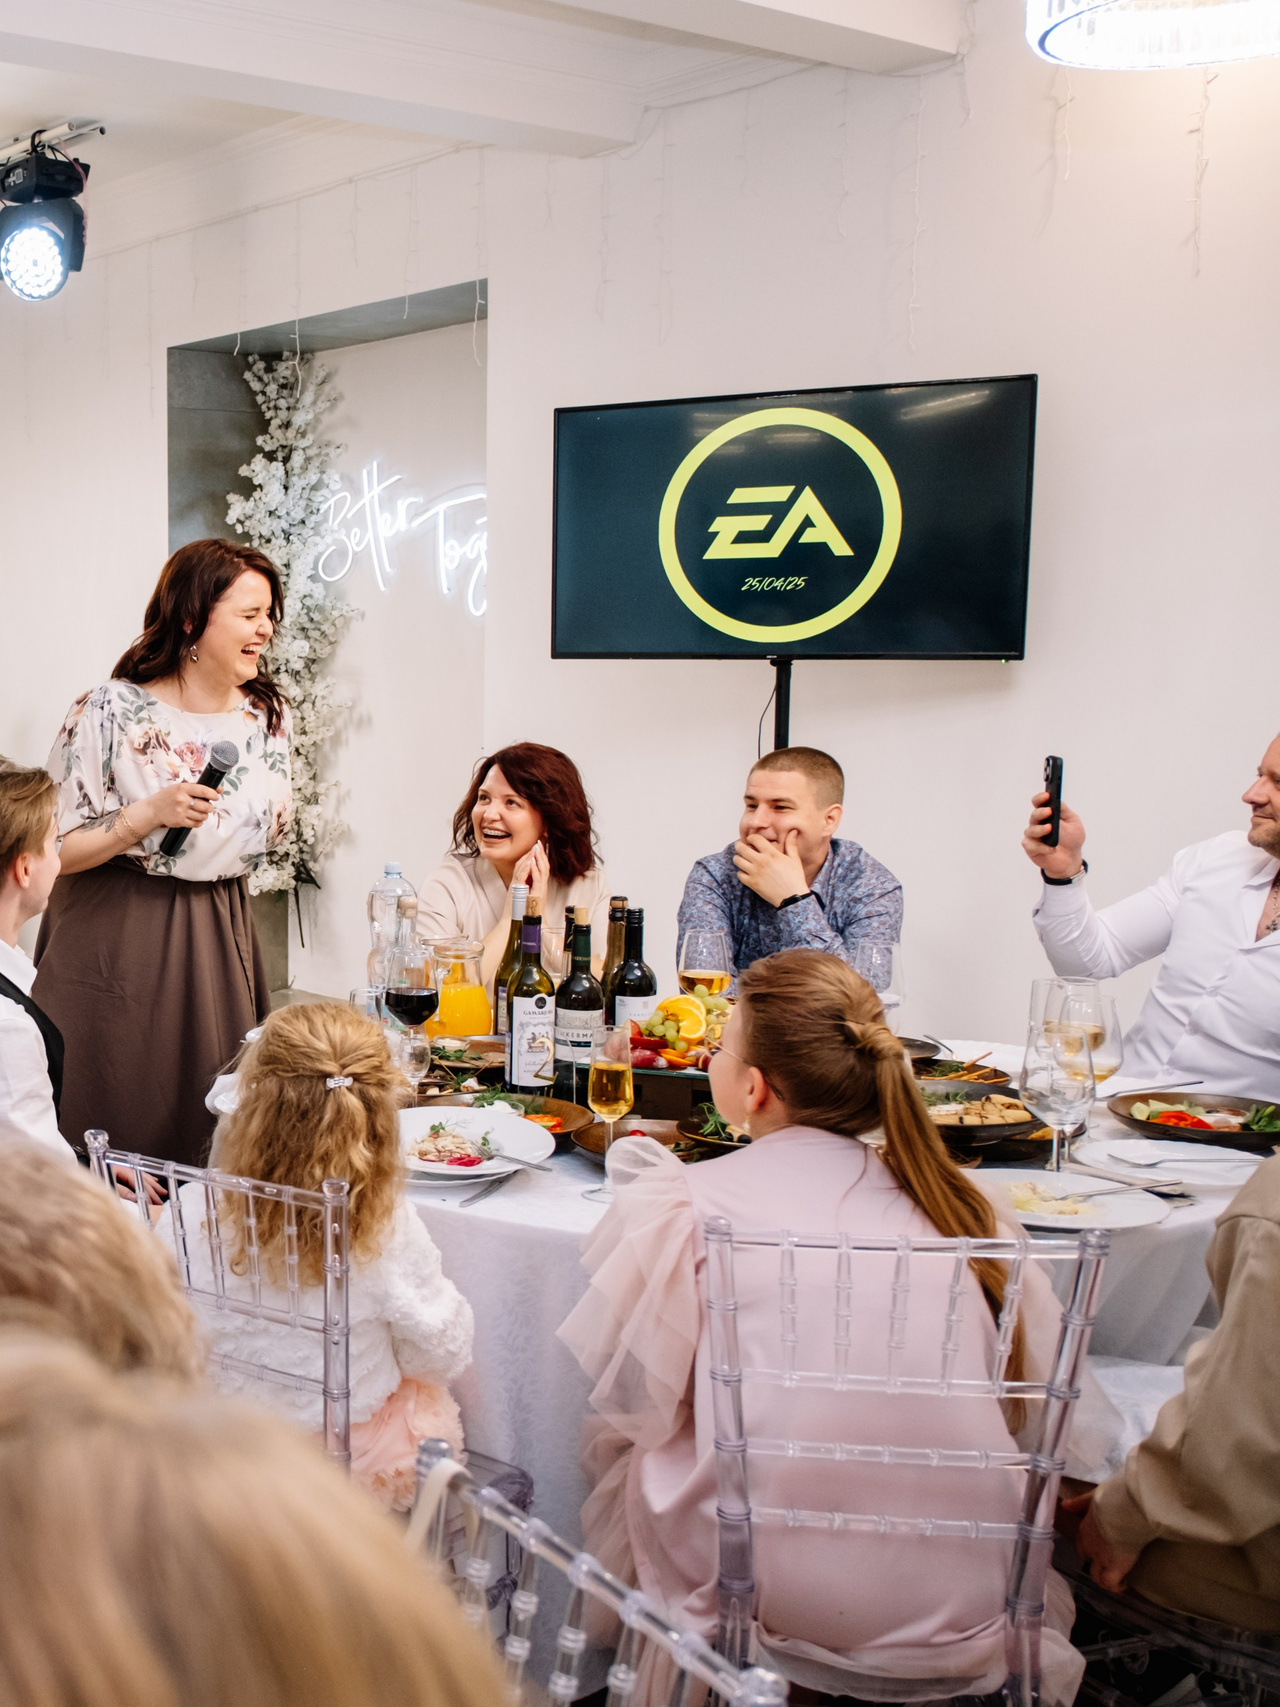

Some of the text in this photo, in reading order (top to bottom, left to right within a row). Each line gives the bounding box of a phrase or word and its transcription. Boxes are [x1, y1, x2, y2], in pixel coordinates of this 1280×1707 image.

[319, 460, 423, 592] Better
[702, 485, 855, 560] EA
[741, 576, 809, 592] 25/04/25
